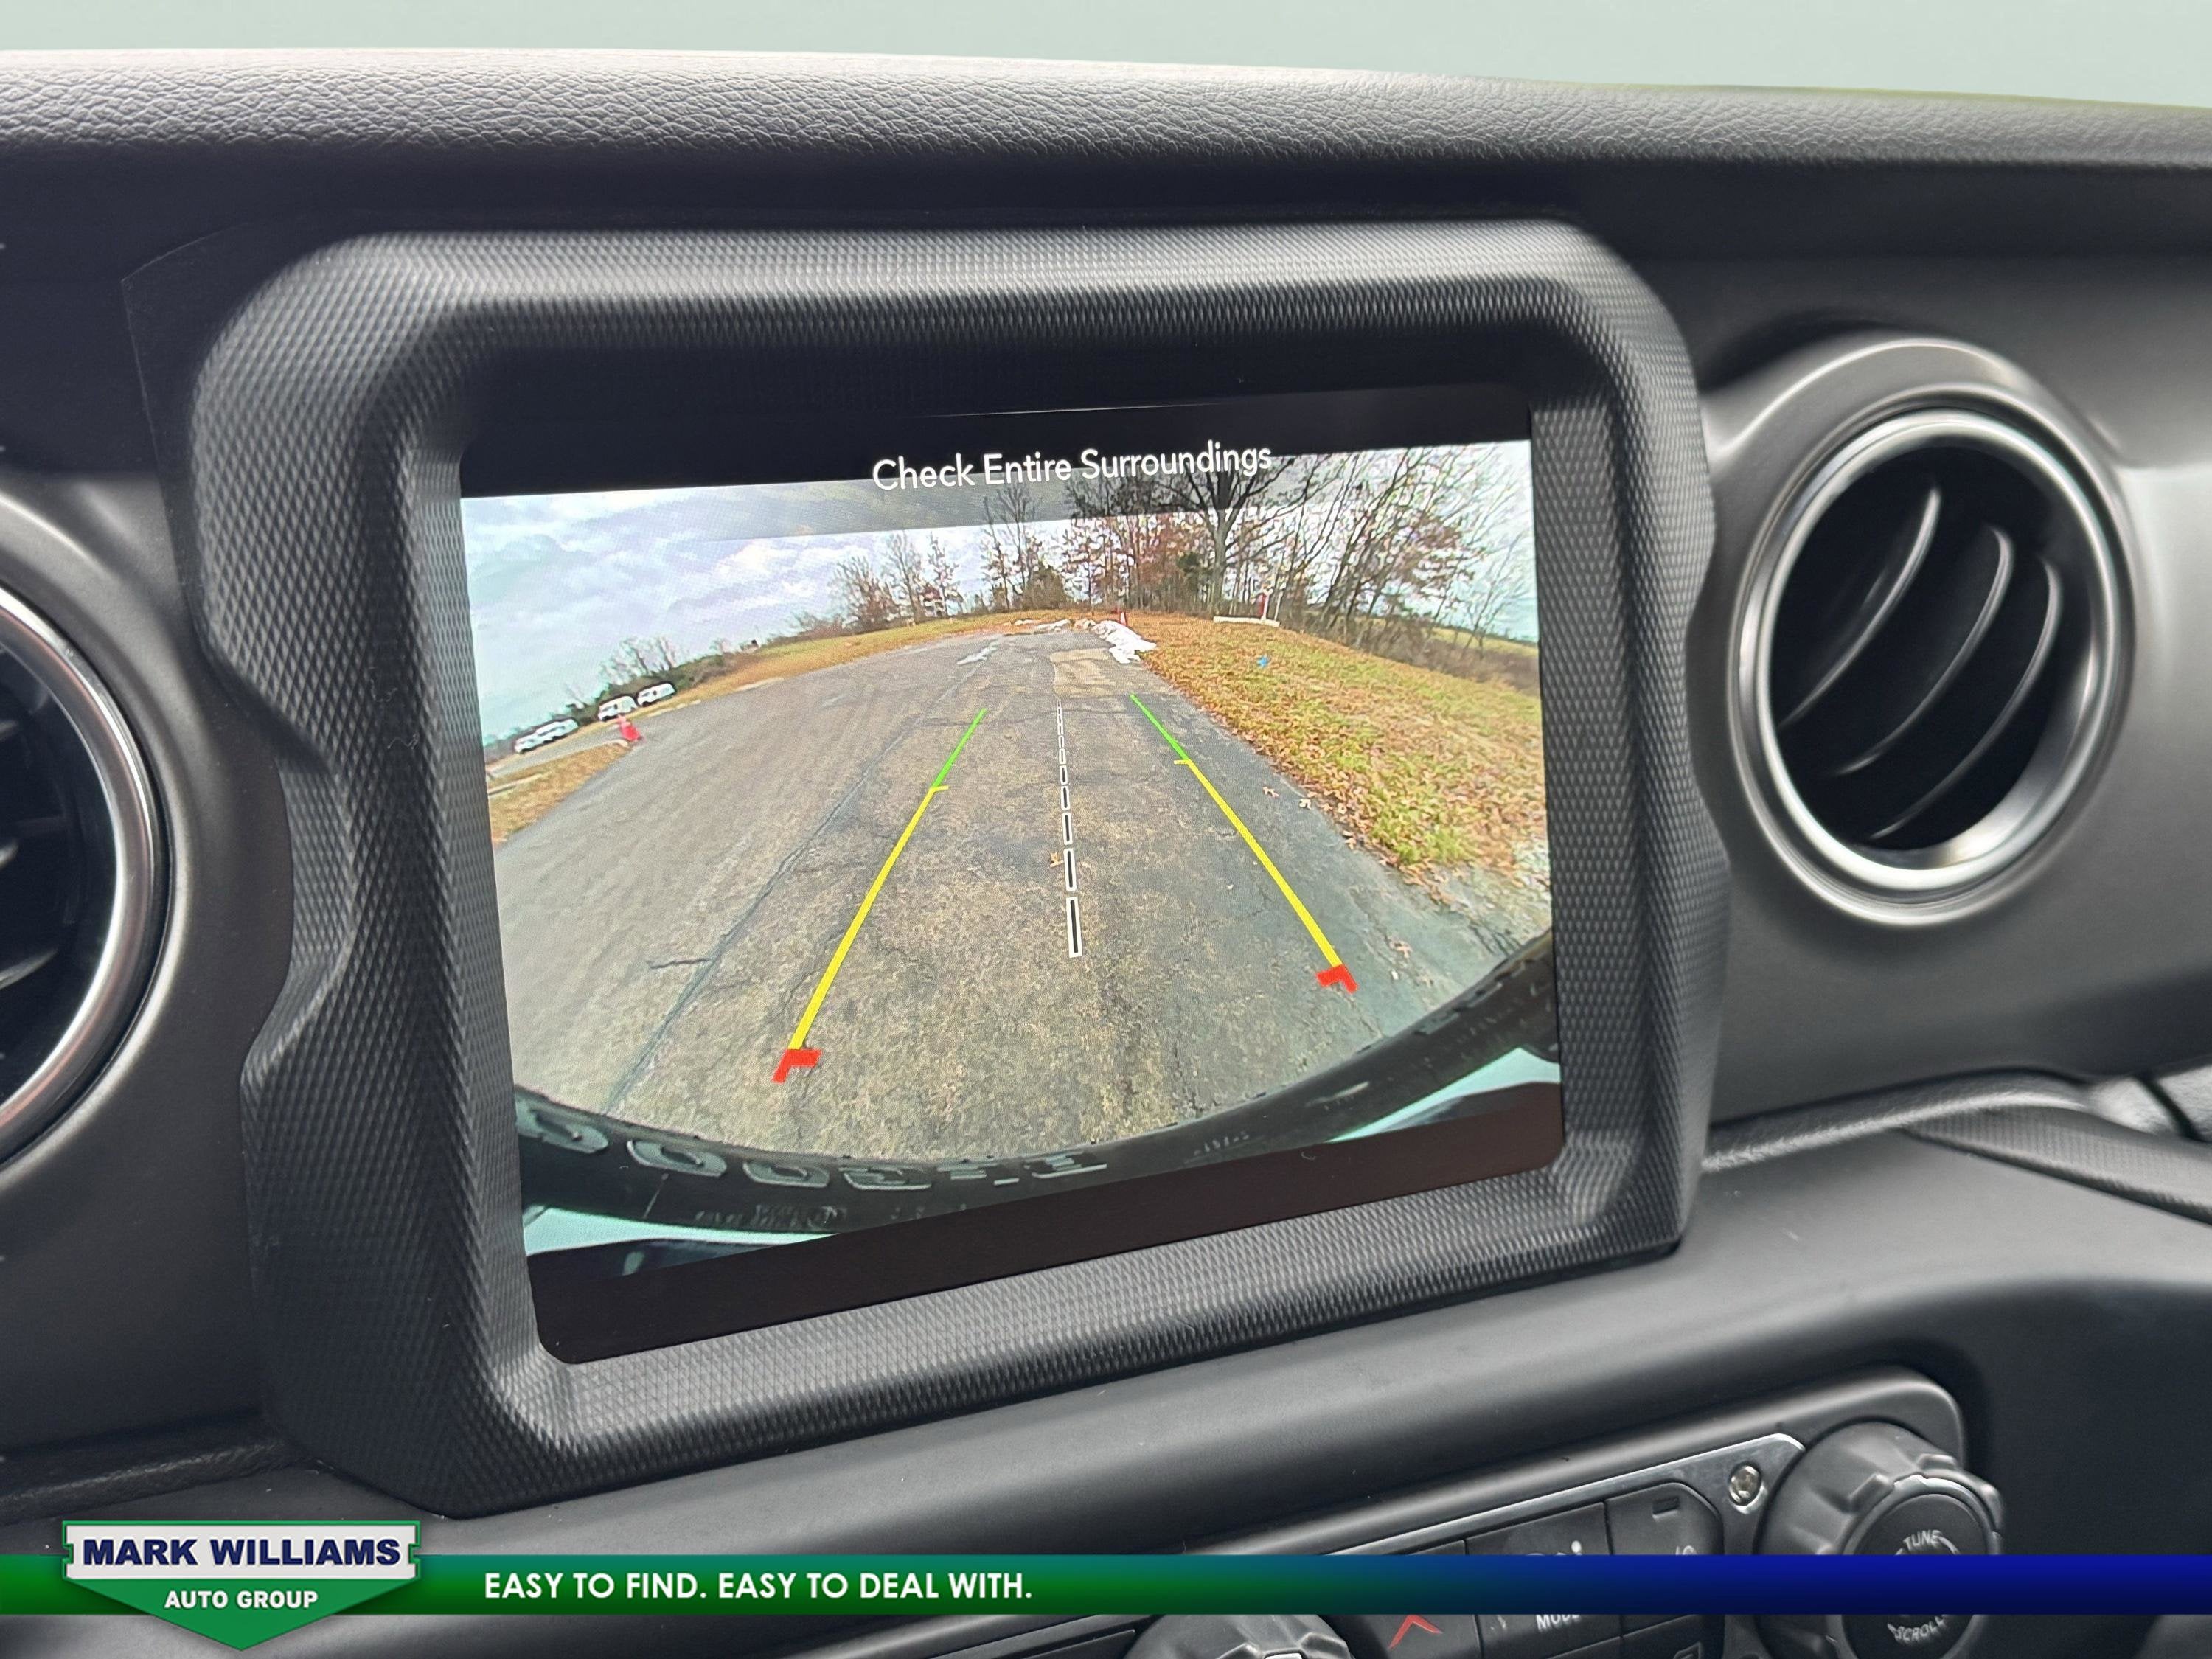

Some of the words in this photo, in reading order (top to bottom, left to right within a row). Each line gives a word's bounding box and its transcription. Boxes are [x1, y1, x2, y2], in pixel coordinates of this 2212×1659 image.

[872, 453, 975, 491] Check
[984, 451, 1072, 485] Entire
[1081, 439, 1272, 479] Surroundings
[1903, 1529, 1941, 1550] TUNE
[1894, 1615, 1945, 1641] SCROLL
